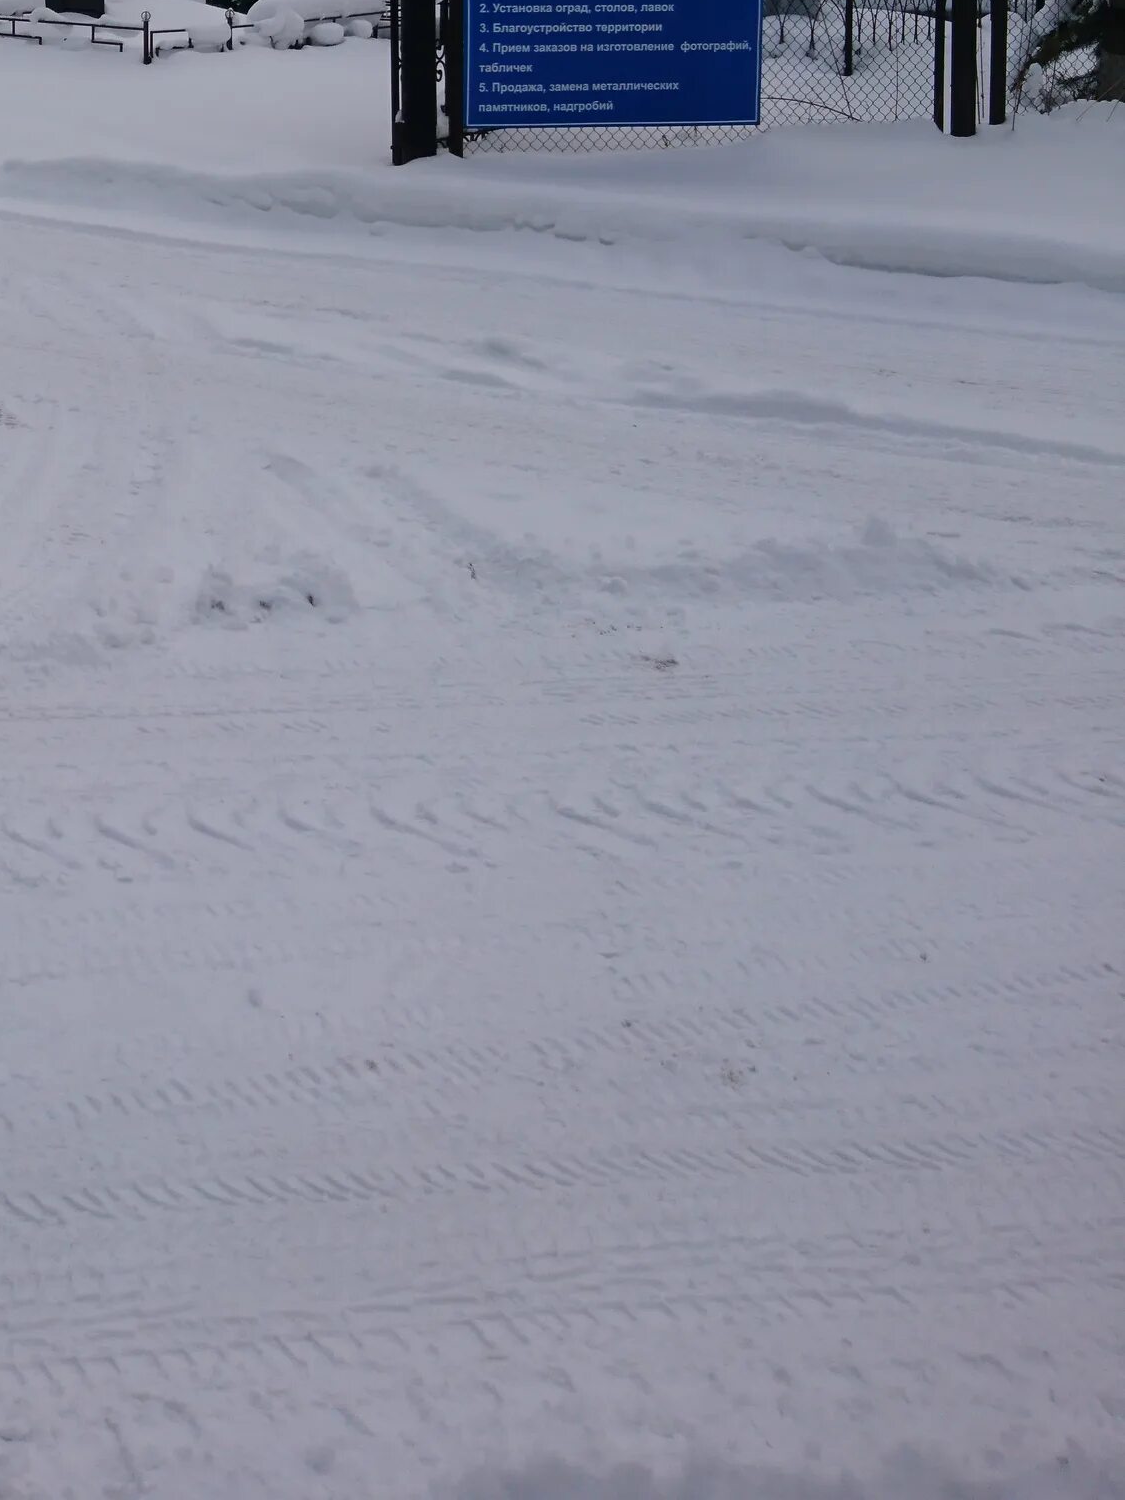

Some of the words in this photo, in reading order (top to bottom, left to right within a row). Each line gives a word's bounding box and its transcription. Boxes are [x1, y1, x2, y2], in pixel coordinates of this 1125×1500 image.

[479, 3, 490, 14] 2.
[492, 2, 553, 13] Установка
[554, 4, 592, 15] оград,
[594, 4, 638, 14] столов,
[639, 3, 675, 12] лавок
[479, 22, 490, 34] 3.
[492, 22, 593, 35] Благоустройство
[594, 23, 663, 34] территории
[478, 42, 490, 53] 4.
[492, 42, 531, 54] Прием
[533, 44, 578, 53] заказов
[579, 43, 594, 52] на
[596, 43, 675, 52] изготовление
[679, 40, 752, 53] фотографий,
[478, 62, 533, 73] табличек
[478, 82, 489, 93] 5.
[491, 81, 547, 94] Продажа,
[548, 83, 590, 92] замена
[591, 82, 680, 91] металлических
[478, 103, 551, 113] памятников,
[552, 100, 614, 113] надгробий
